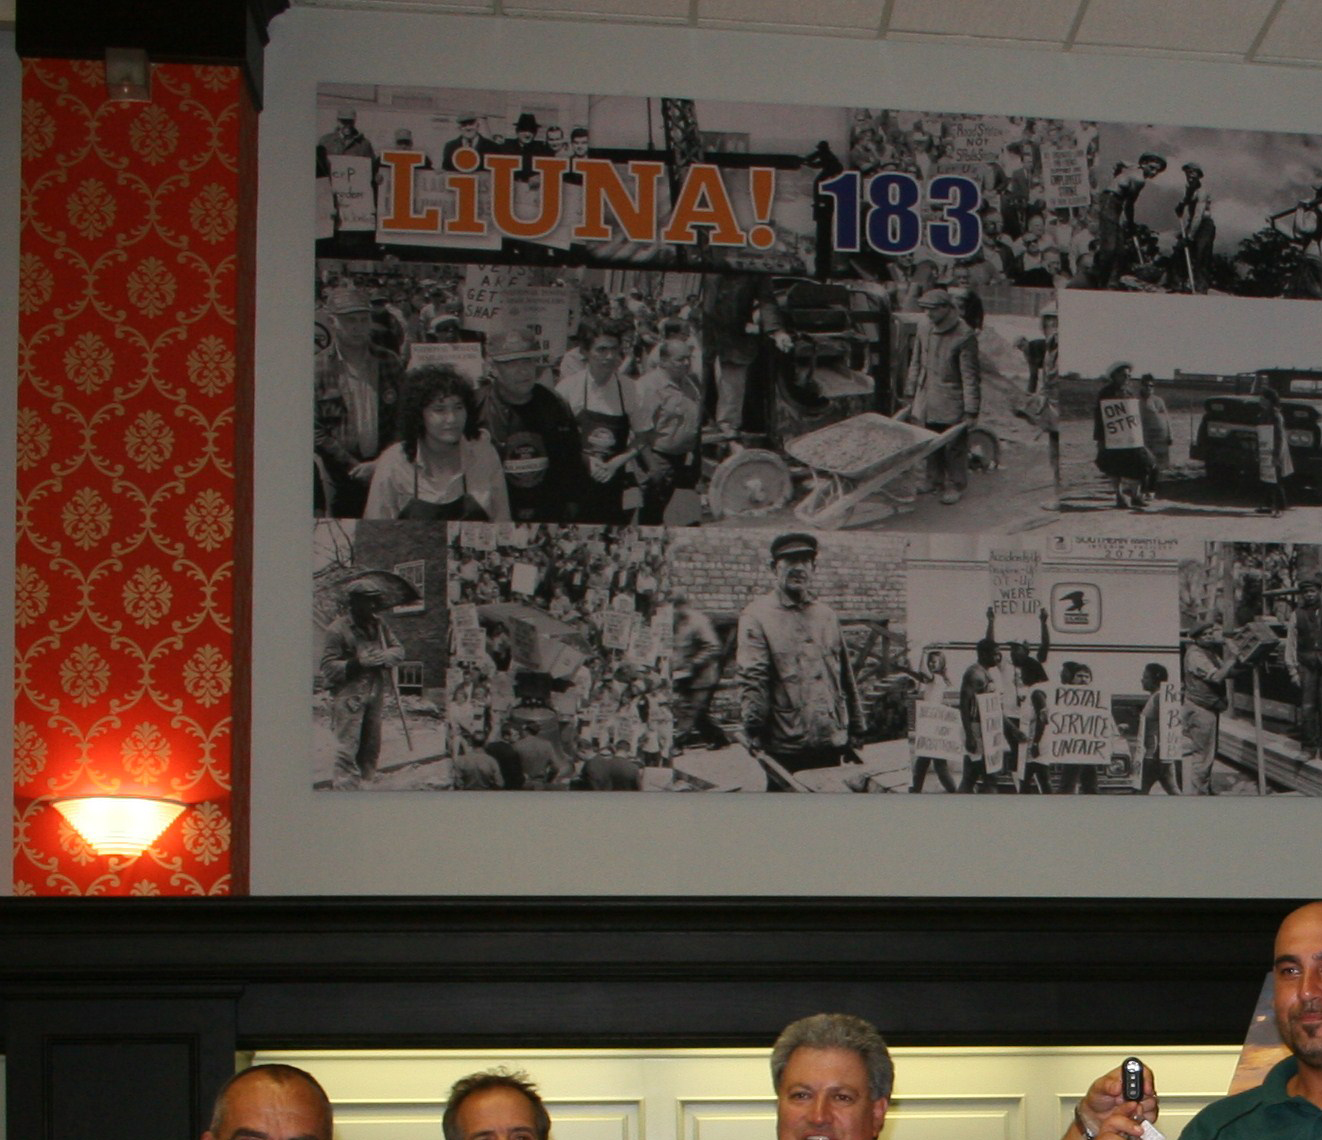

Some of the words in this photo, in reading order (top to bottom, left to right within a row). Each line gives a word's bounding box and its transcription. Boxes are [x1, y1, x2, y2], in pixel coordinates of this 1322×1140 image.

[381, 148, 776, 251] LiUNA!
[819, 171, 983, 259] 183
[1104, 401, 1126, 418] ON
[1055, 687, 1108, 710] POSTAL
[1050, 712, 1110, 739] SERVICE
[1052, 738, 1106, 760] UNFAIR
